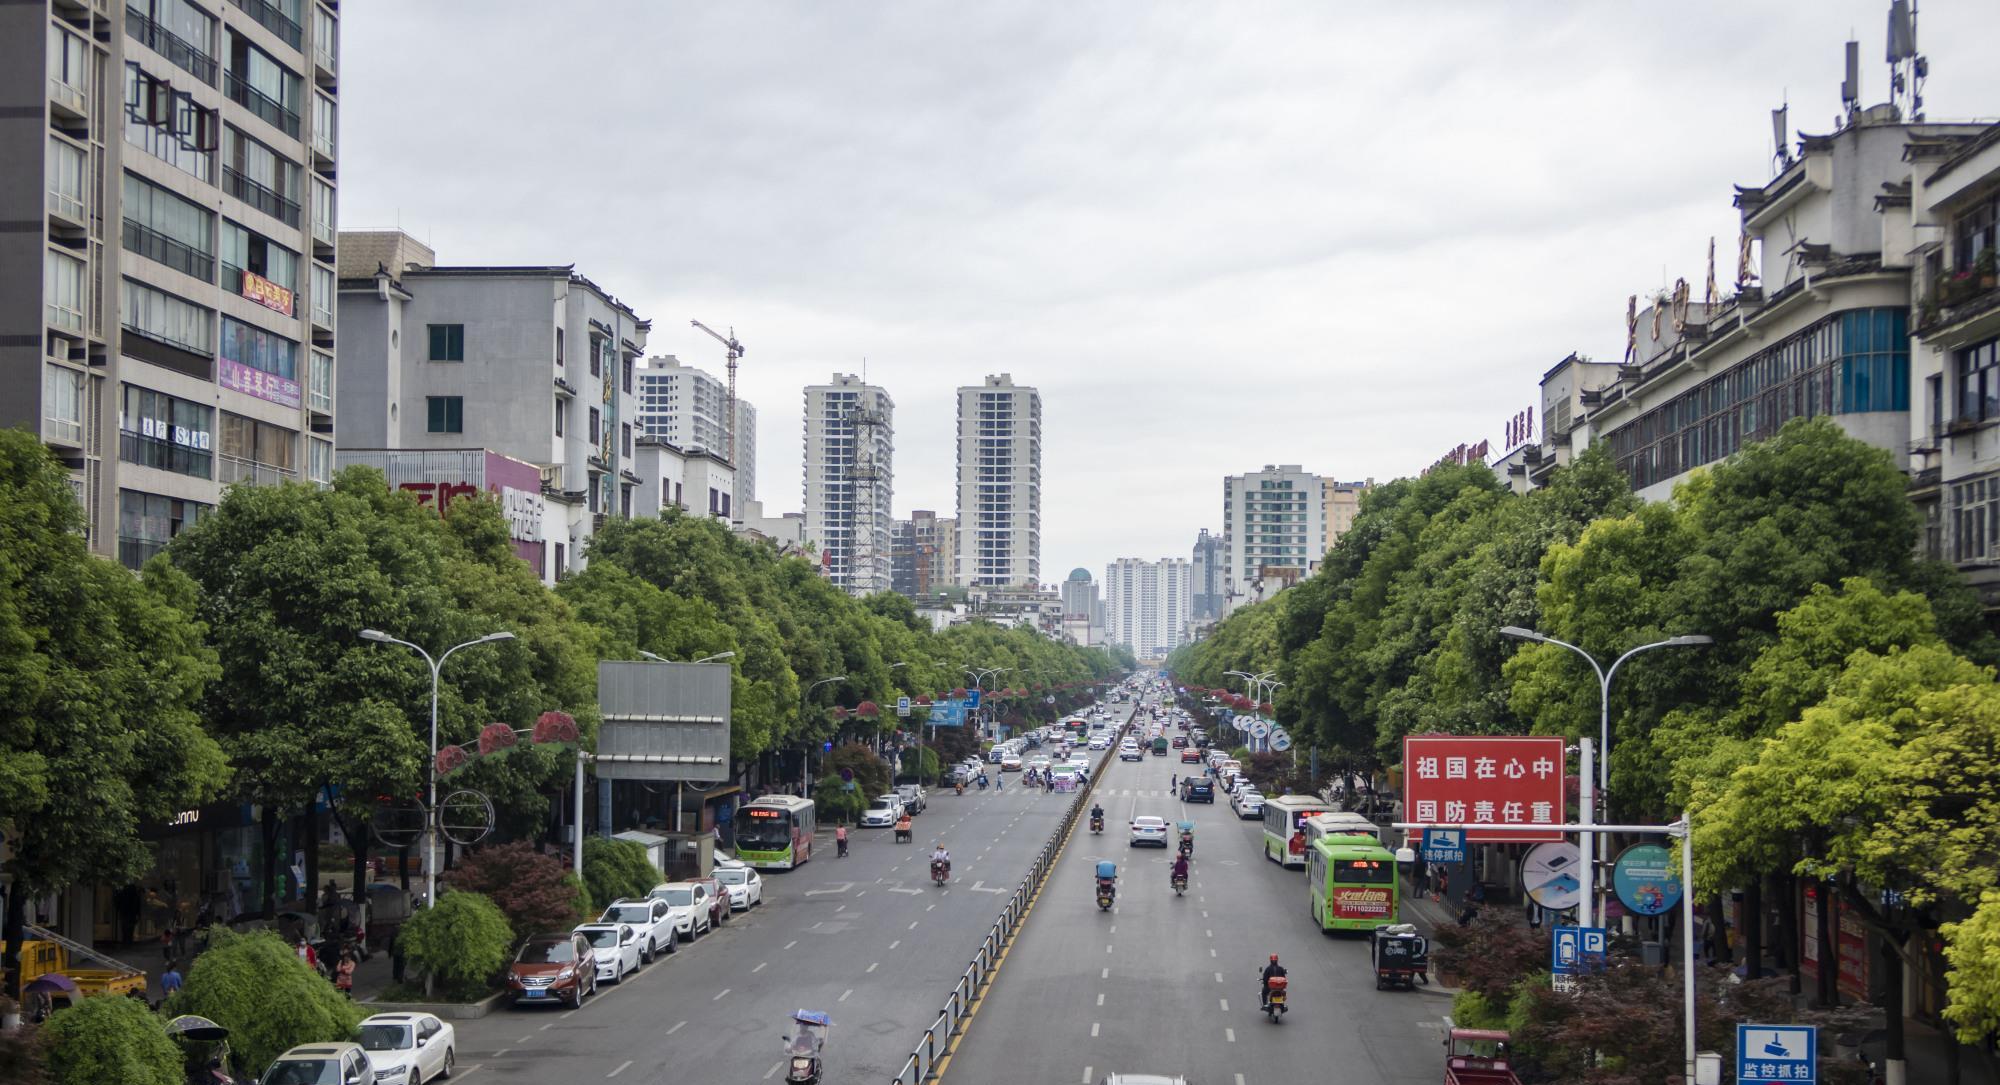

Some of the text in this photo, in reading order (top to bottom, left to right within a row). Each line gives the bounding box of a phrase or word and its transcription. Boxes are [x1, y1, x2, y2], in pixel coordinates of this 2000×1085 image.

[1416, 756, 1554, 780] 祖国在心中
[1416, 800, 1553, 824] 国防责任重
[1424, 849, 1464, 861] 违停抓拍
[1588, 935, 1600, 950] P
[1743, 1062, 1809, 1079] 监控抓拍
